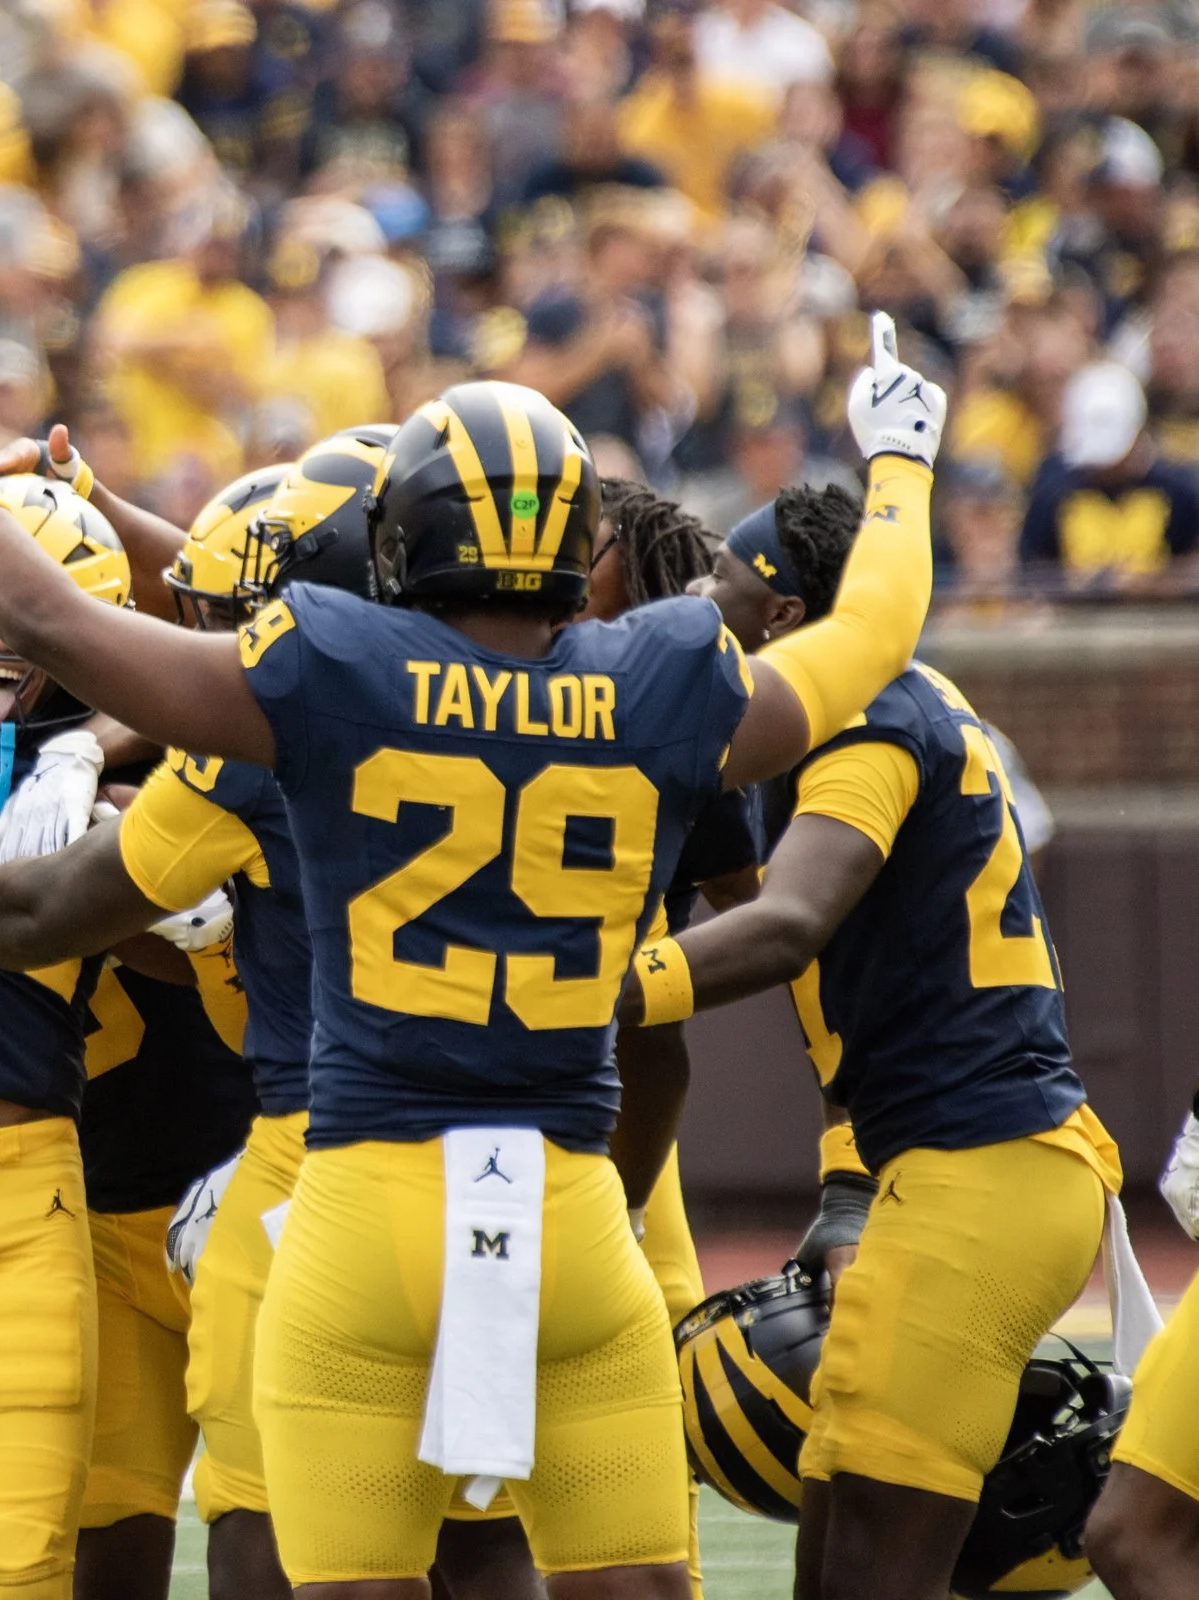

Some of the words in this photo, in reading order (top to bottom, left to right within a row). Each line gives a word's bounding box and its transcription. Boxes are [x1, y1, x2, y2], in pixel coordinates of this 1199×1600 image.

[513, 499, 536, 510] C2P
[458, 545, 479, 563] 29
[753, 552, 778, 579] M
[406, 660, 616, 741] TAYLOR
[348, 748, 659, 1031] 29
[641, 948, 667, 975] M
[471, 1229, 511, 1261] M
